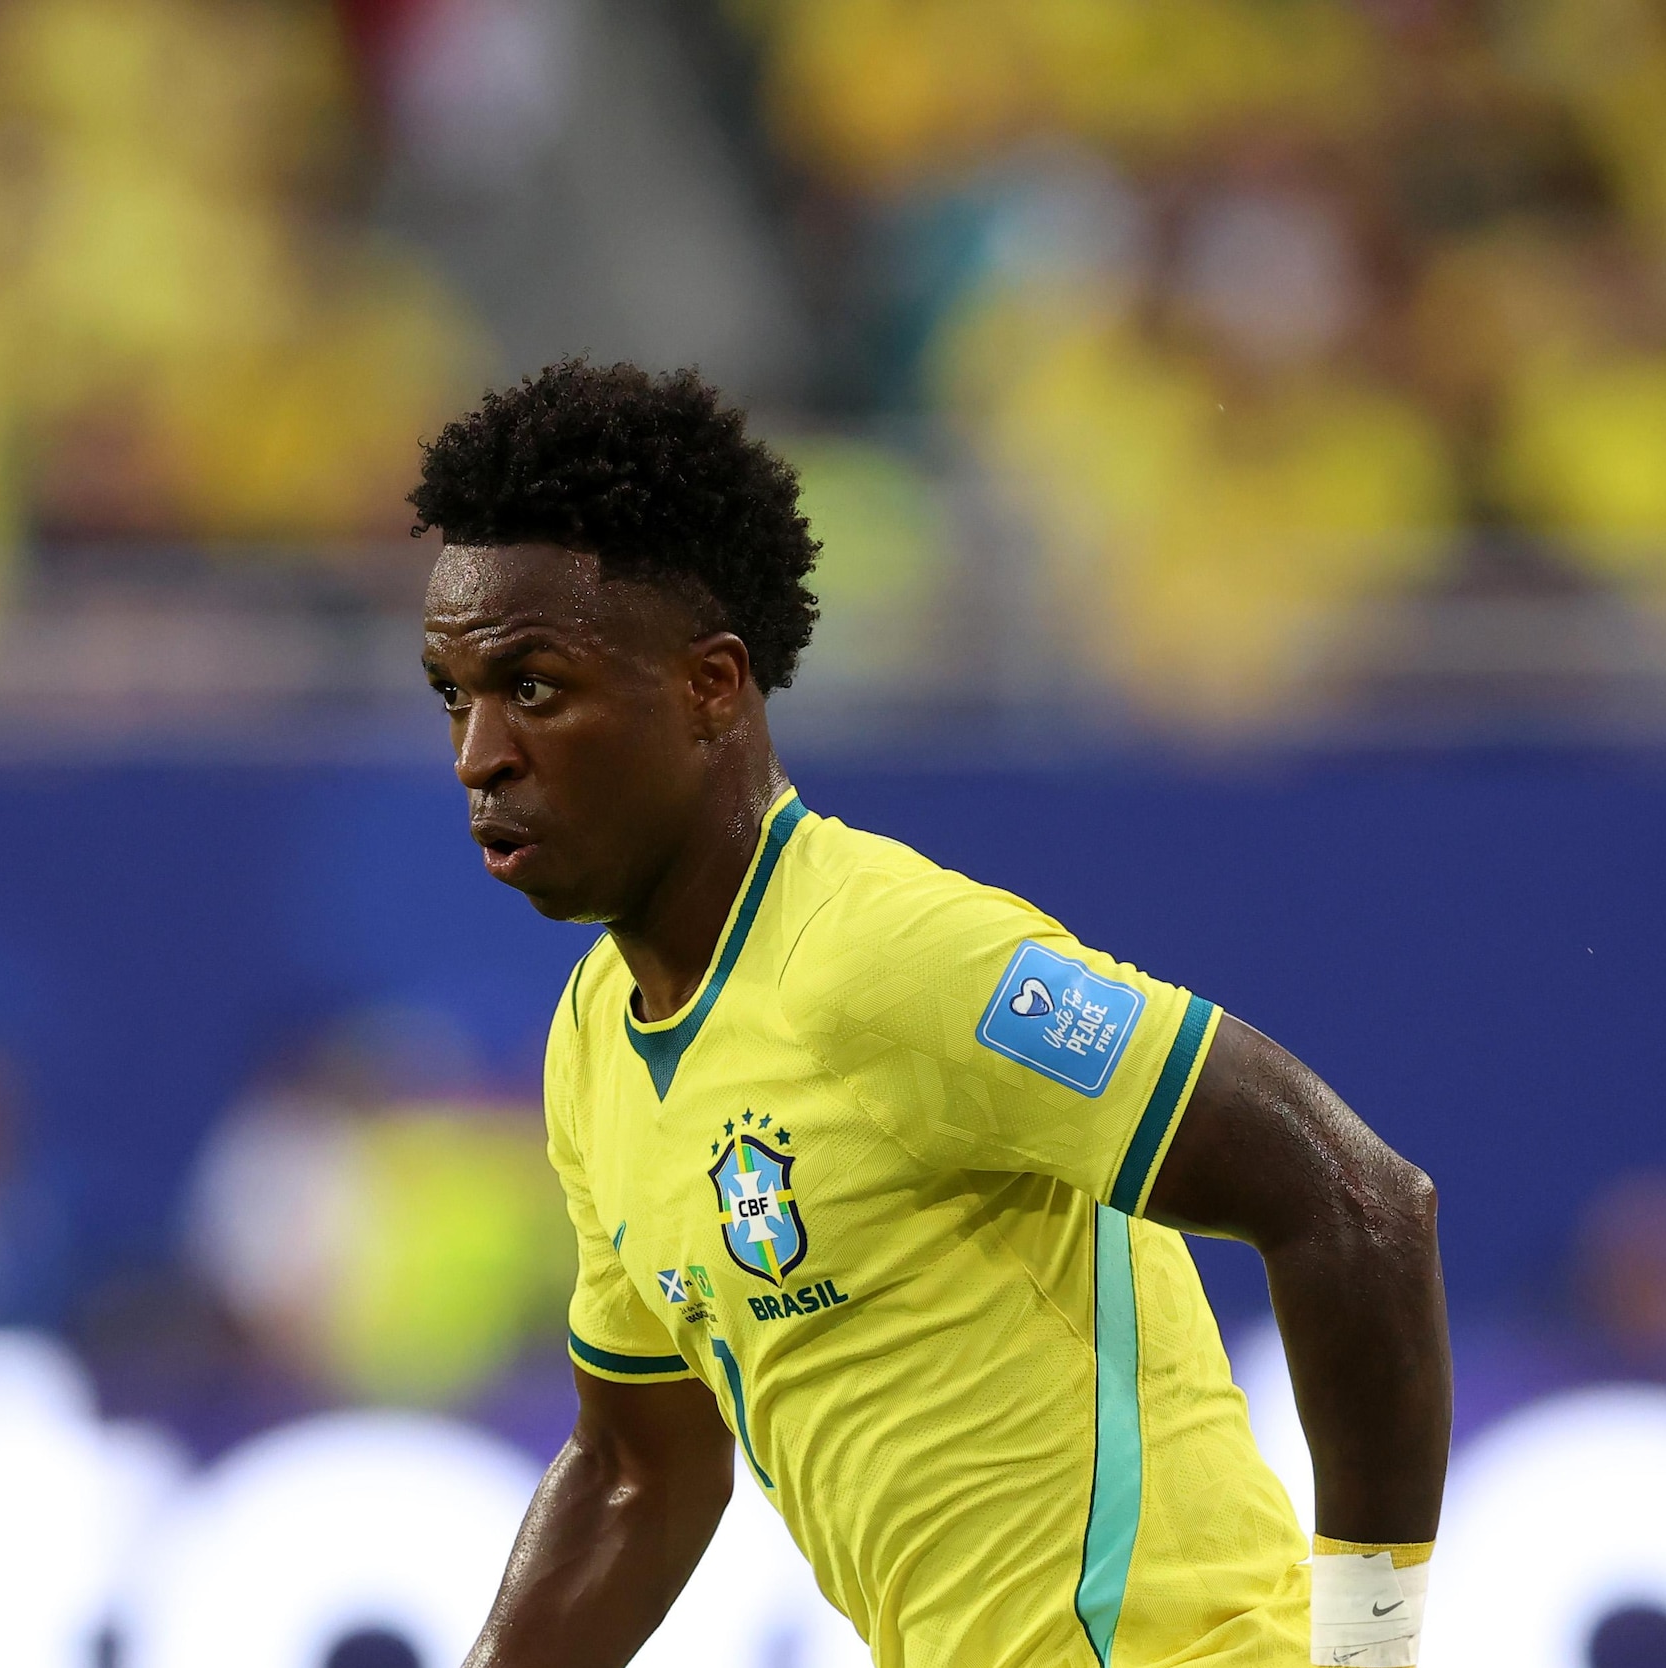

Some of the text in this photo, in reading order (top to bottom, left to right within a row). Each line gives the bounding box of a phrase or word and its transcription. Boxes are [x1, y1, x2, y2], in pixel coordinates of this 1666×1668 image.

[1043, 988, 1083, 1049] Unite For
[1066, 1001, 1108, 1056] PEACE
[1096, 1024, 1117, 1053] FIFA
[738, 1197, 769, 1218] CBF
[747, 1279, 849, 1321] BRASIL
